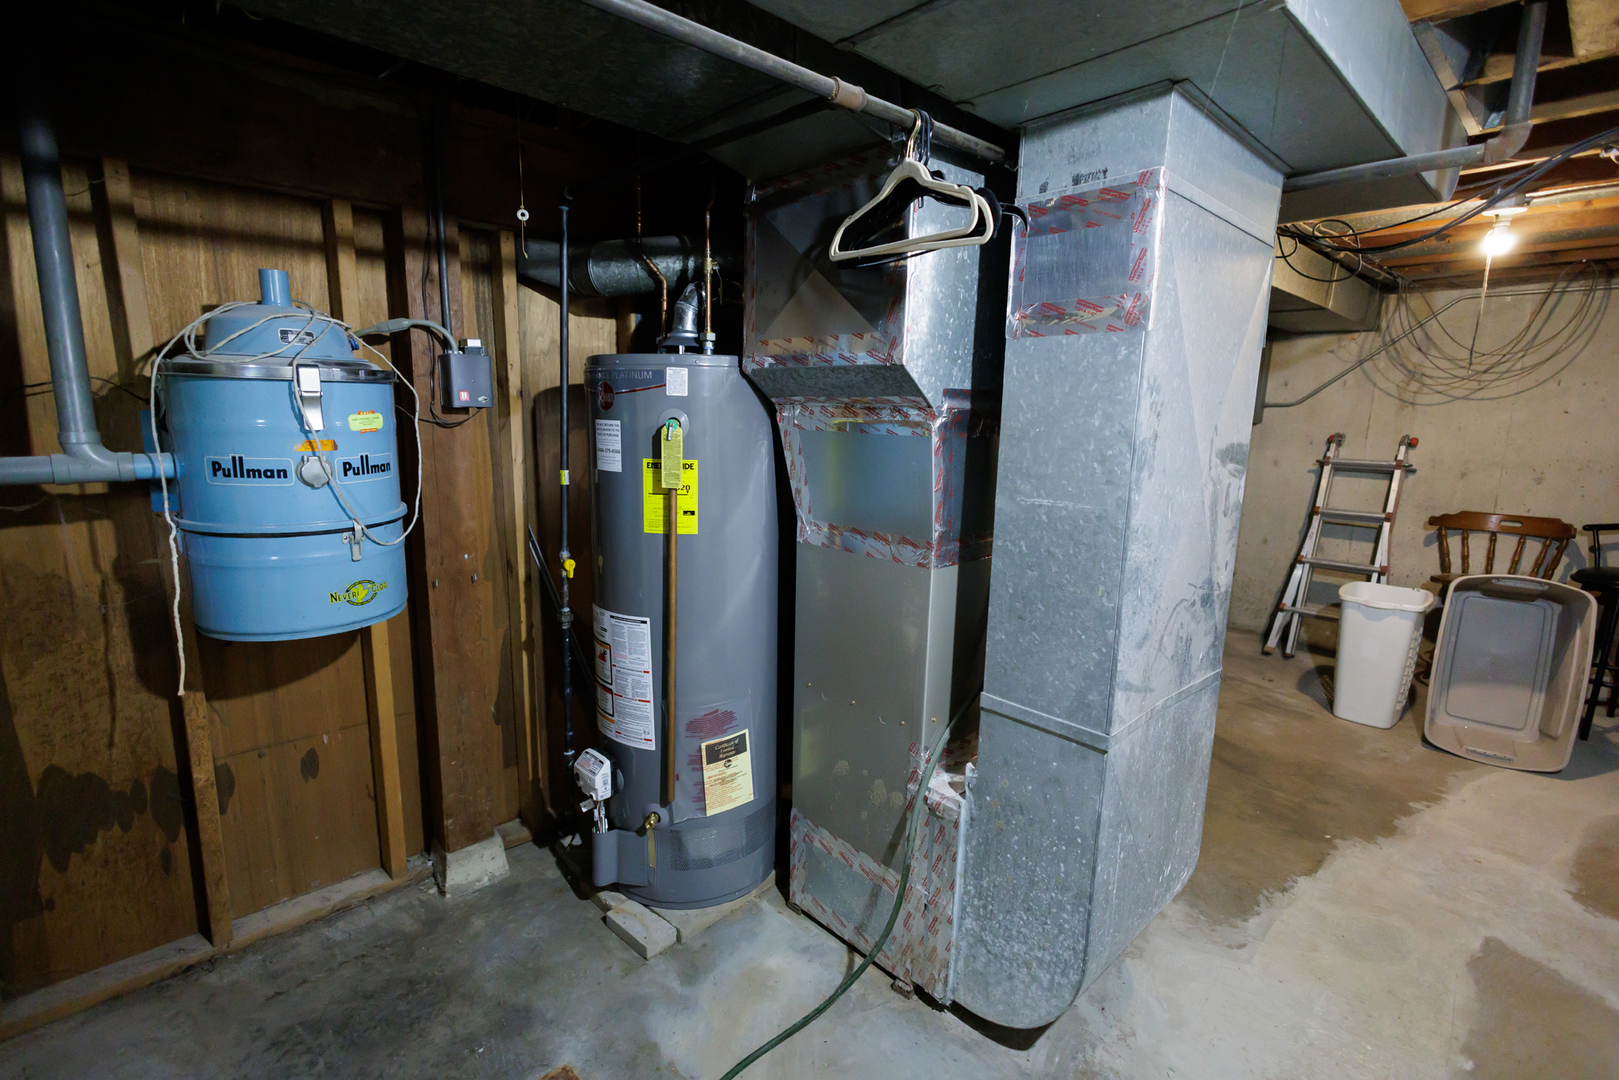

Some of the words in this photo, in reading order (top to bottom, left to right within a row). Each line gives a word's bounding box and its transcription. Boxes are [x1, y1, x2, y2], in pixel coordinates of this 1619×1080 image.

[1132, 212, 1146, 233] Venture
[1142, 198, 1153, 212] Tape
[1128, 260, 1142, 281] Venture
[1138, 247, 1148, 261] Tape
[1076, 300, 1092, 309] Venture
[611, 371, 653, 379] PLATINUM
[212, 455, 288, 479] Pullman
[343, 454, 391, 477] Pullman
[371, 582, 388, 593] CLOG
